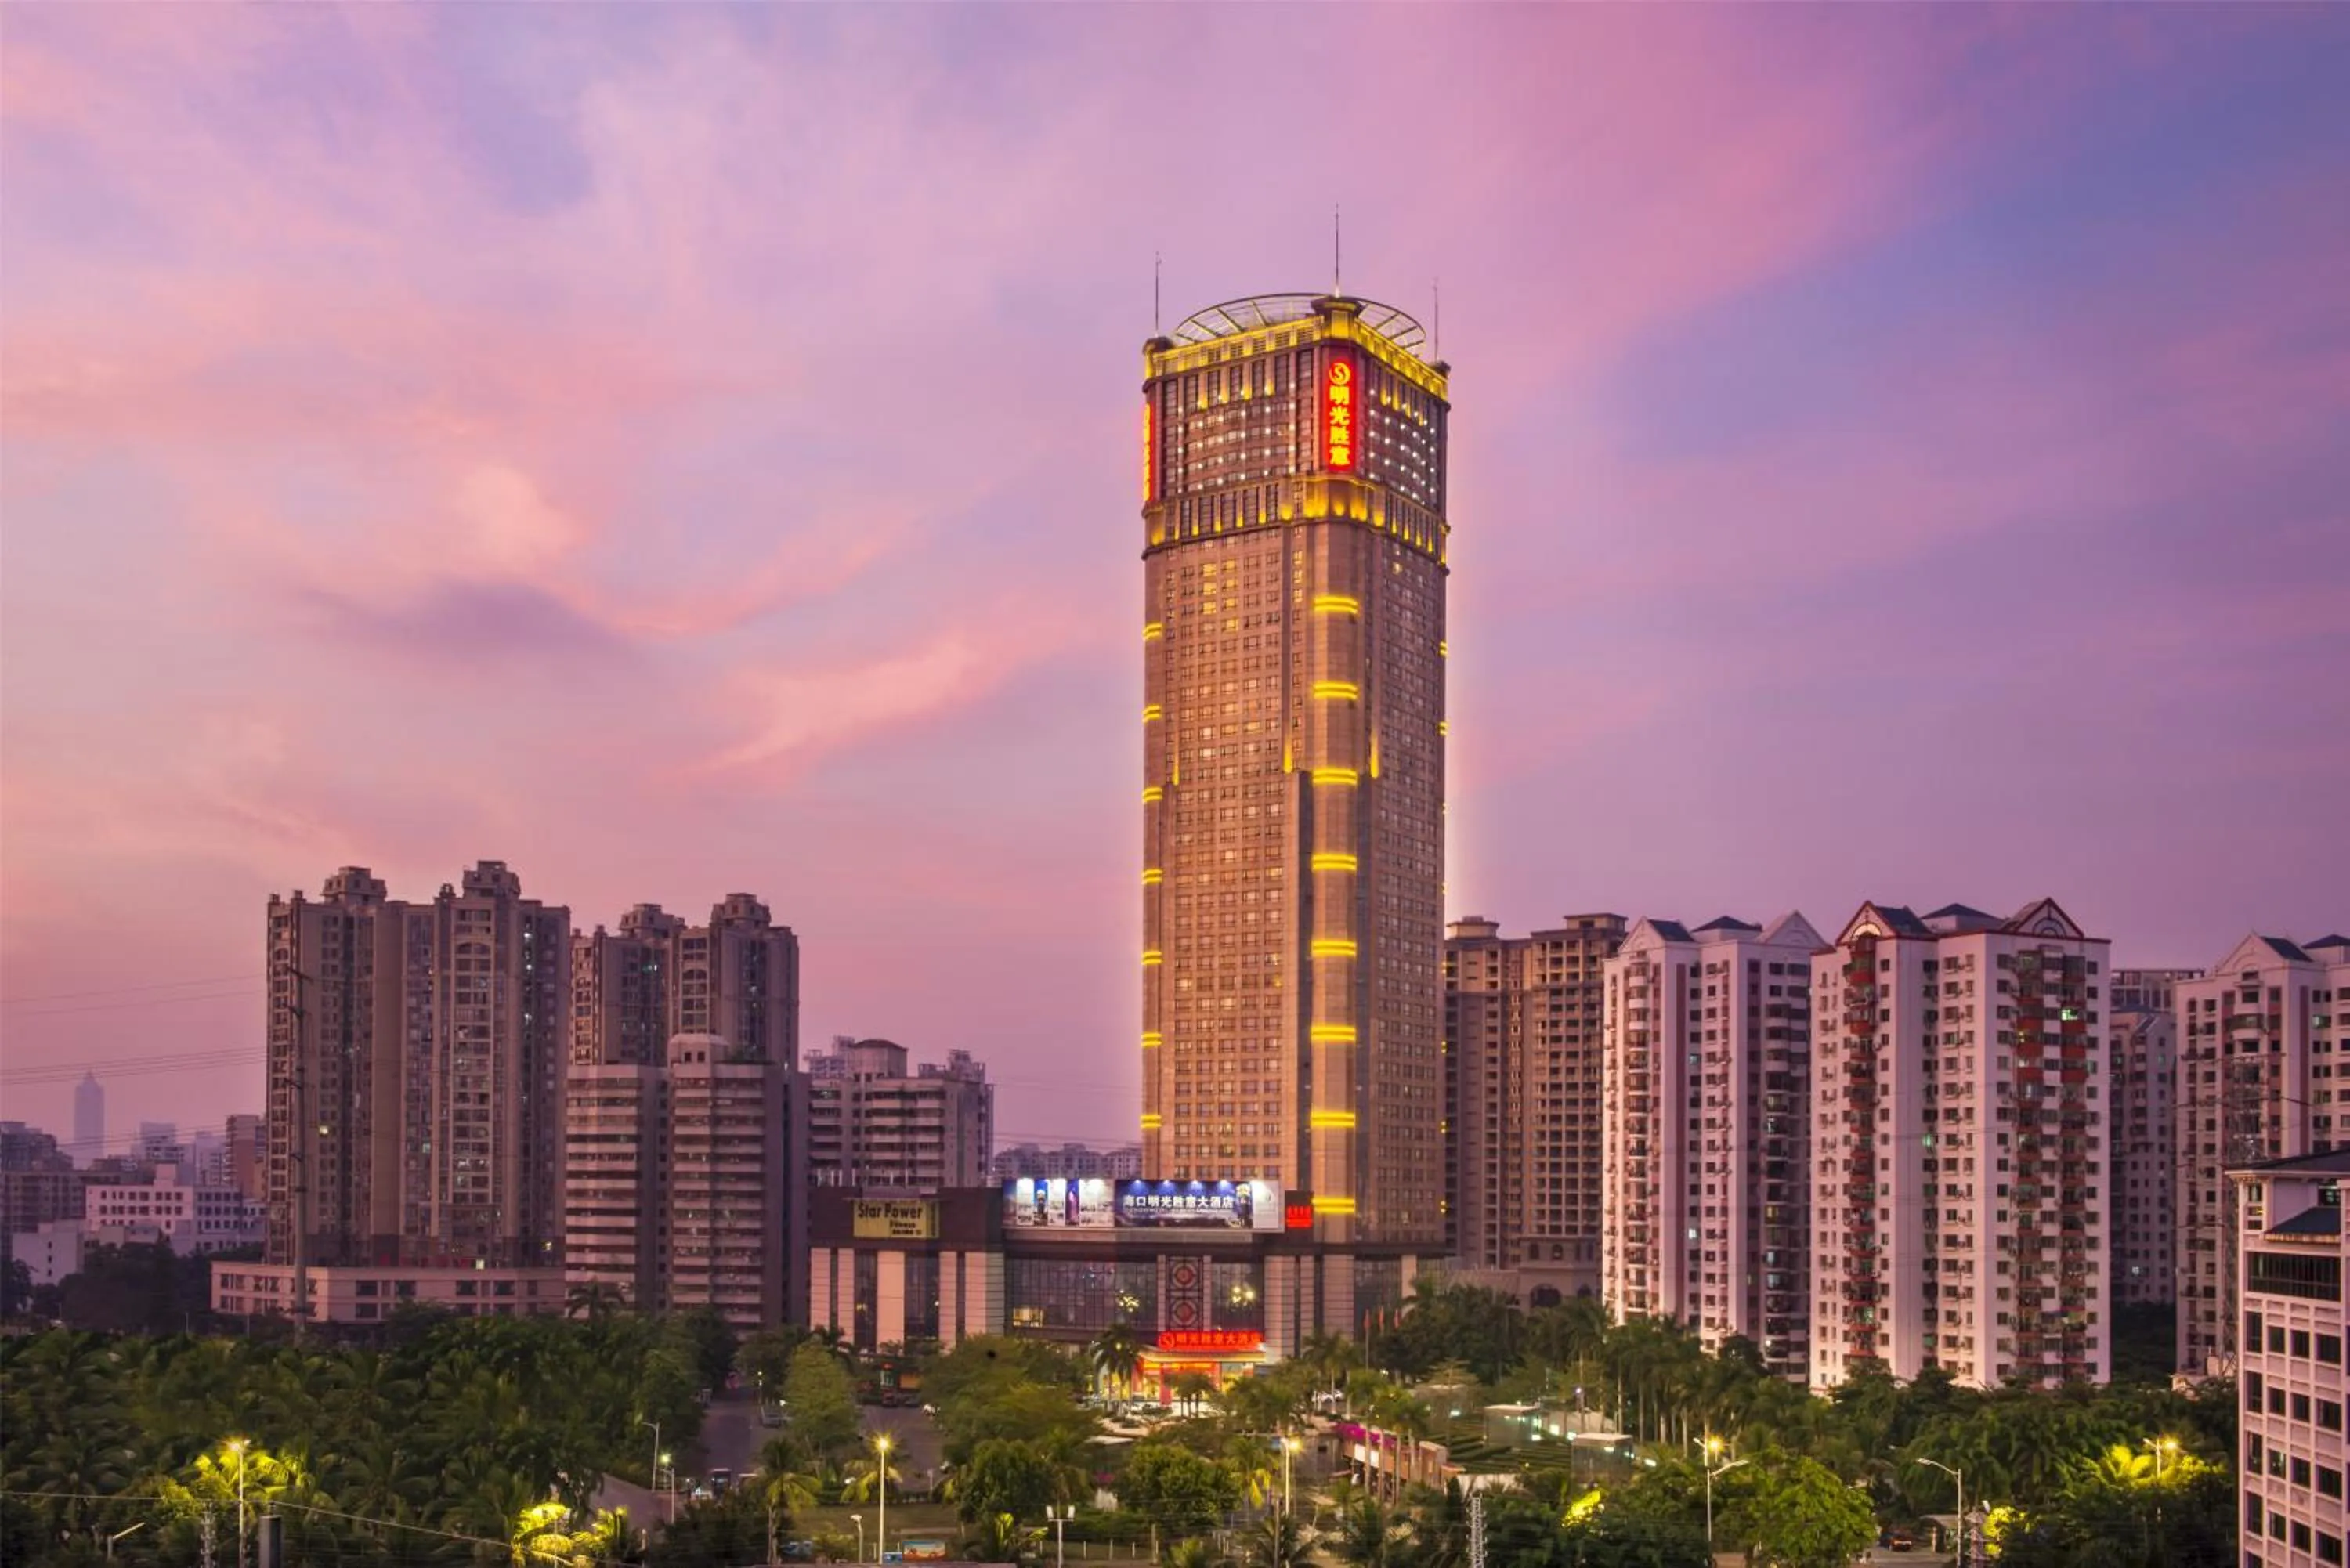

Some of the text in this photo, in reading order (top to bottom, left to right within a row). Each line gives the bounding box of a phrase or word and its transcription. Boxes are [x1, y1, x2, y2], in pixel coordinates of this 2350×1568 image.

[1329, 385, 1350, 466] 明光胜意
[858, 1202, 923, 1219] Star Power
